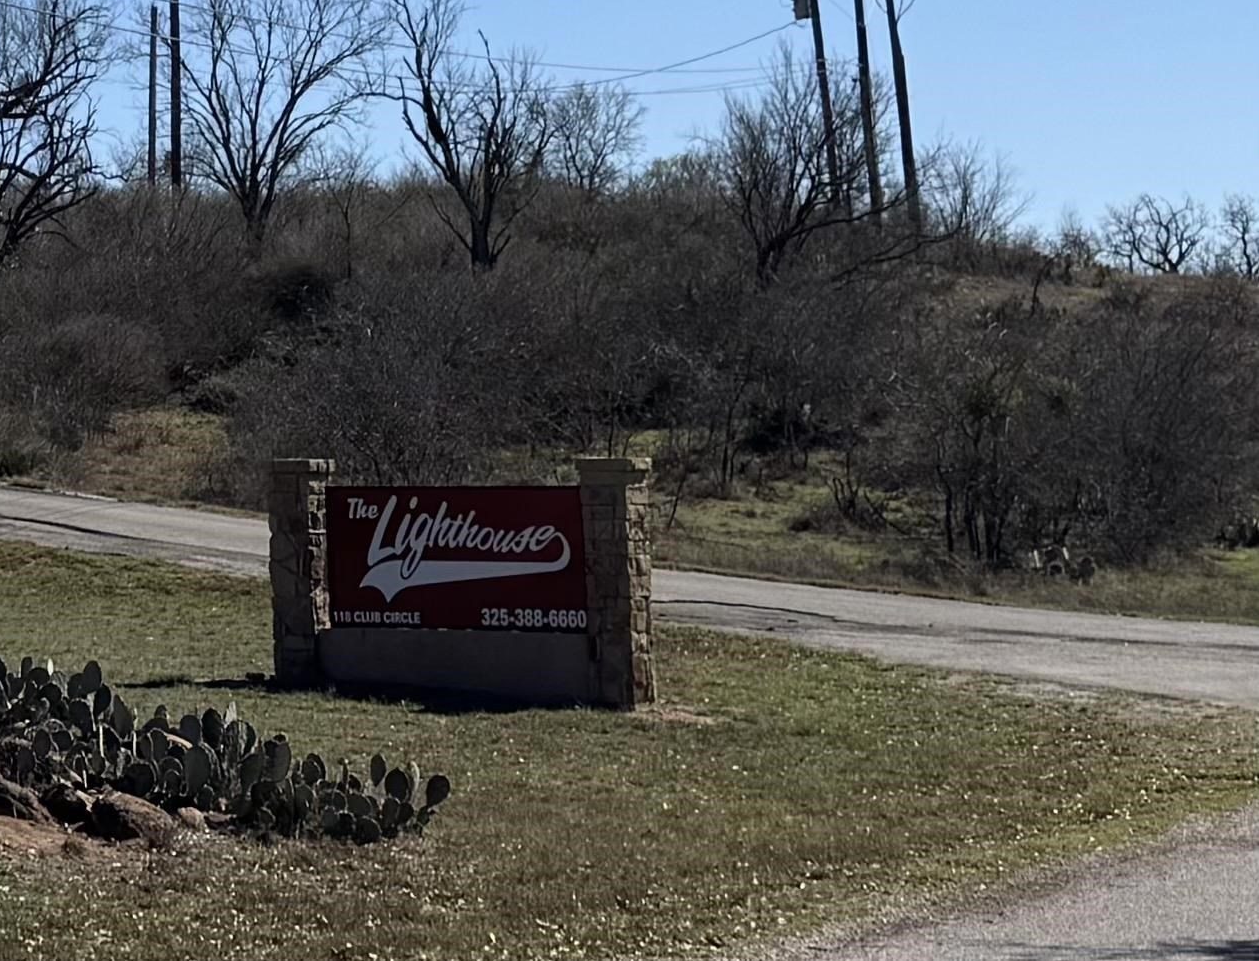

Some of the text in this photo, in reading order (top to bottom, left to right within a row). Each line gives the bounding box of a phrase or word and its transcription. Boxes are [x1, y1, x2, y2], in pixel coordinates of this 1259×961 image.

[347, 495, 562, 579] The Lighthouse
[353, 611, 381, 623] CLUB
[383, 611, 422, 624] CIRCLE
[481, 607, 588, 628] 325-388-6660
